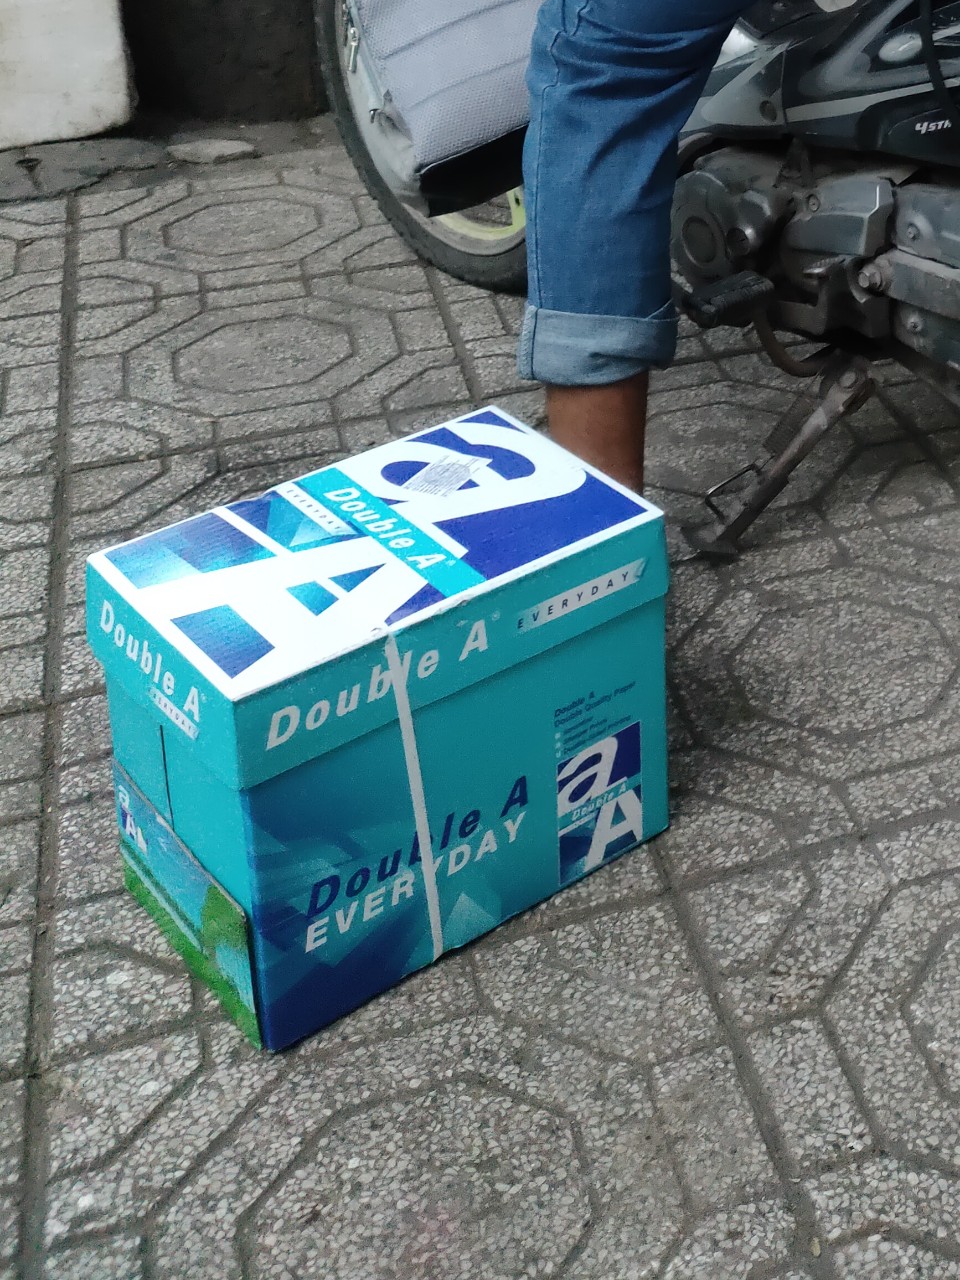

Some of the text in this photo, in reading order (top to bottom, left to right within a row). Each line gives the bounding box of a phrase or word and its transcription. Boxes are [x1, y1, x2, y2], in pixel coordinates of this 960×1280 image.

[286, 489, 344, 531] EVERYDAY
[323, 487, 447, 571] Double A
[516, 570, 630, 629] EVERYDAY
[100, 599, 200, 722] Double A
[265, 619, 489, 751] Double A
[500, 775, 529, 820] A
[571, 792, 615, 822] Double
[618, 782, 628, 794] A
